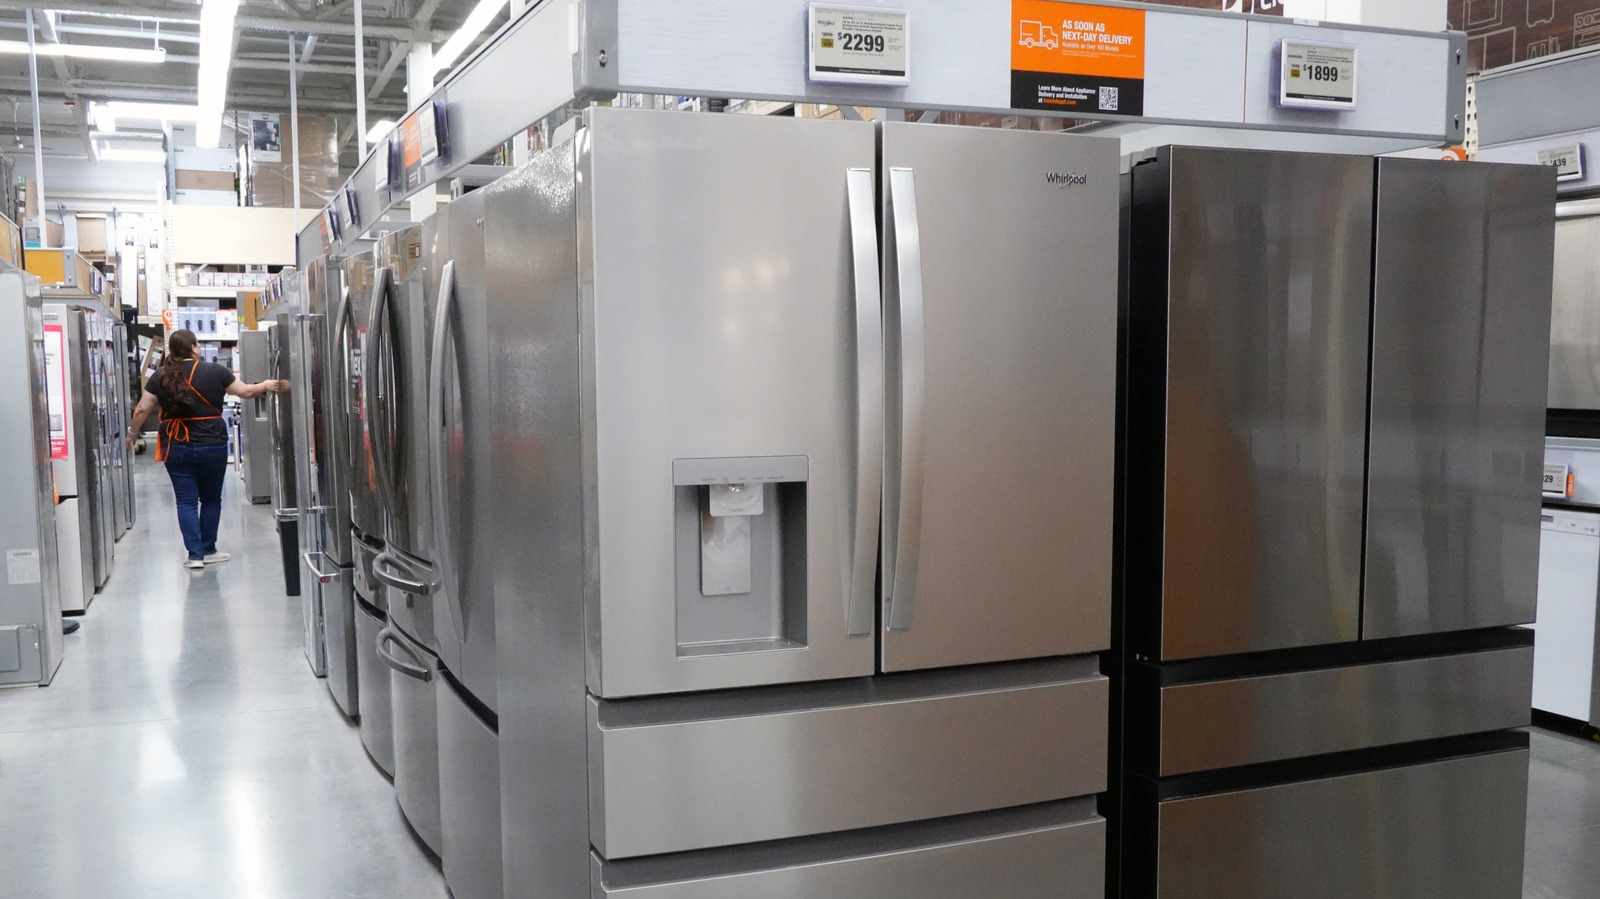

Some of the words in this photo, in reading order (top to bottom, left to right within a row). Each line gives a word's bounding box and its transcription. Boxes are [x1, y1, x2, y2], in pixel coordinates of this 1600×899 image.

[1062, 20, 1073, 29] AS
[1074, 21, 1094, 31] SOON
[1095, 23, 1105, 32] AS
[838, 32, 884, 52] $2299
[1062, 31, 1097, 42] NEXT-DAY
[1303, 64, 1338, 82] $1899
[1075, 87, 1096, 95] Appliance
[1046, 172, 1087, 188] Whirlpool
[1543, 475, 1553, 483] 29
